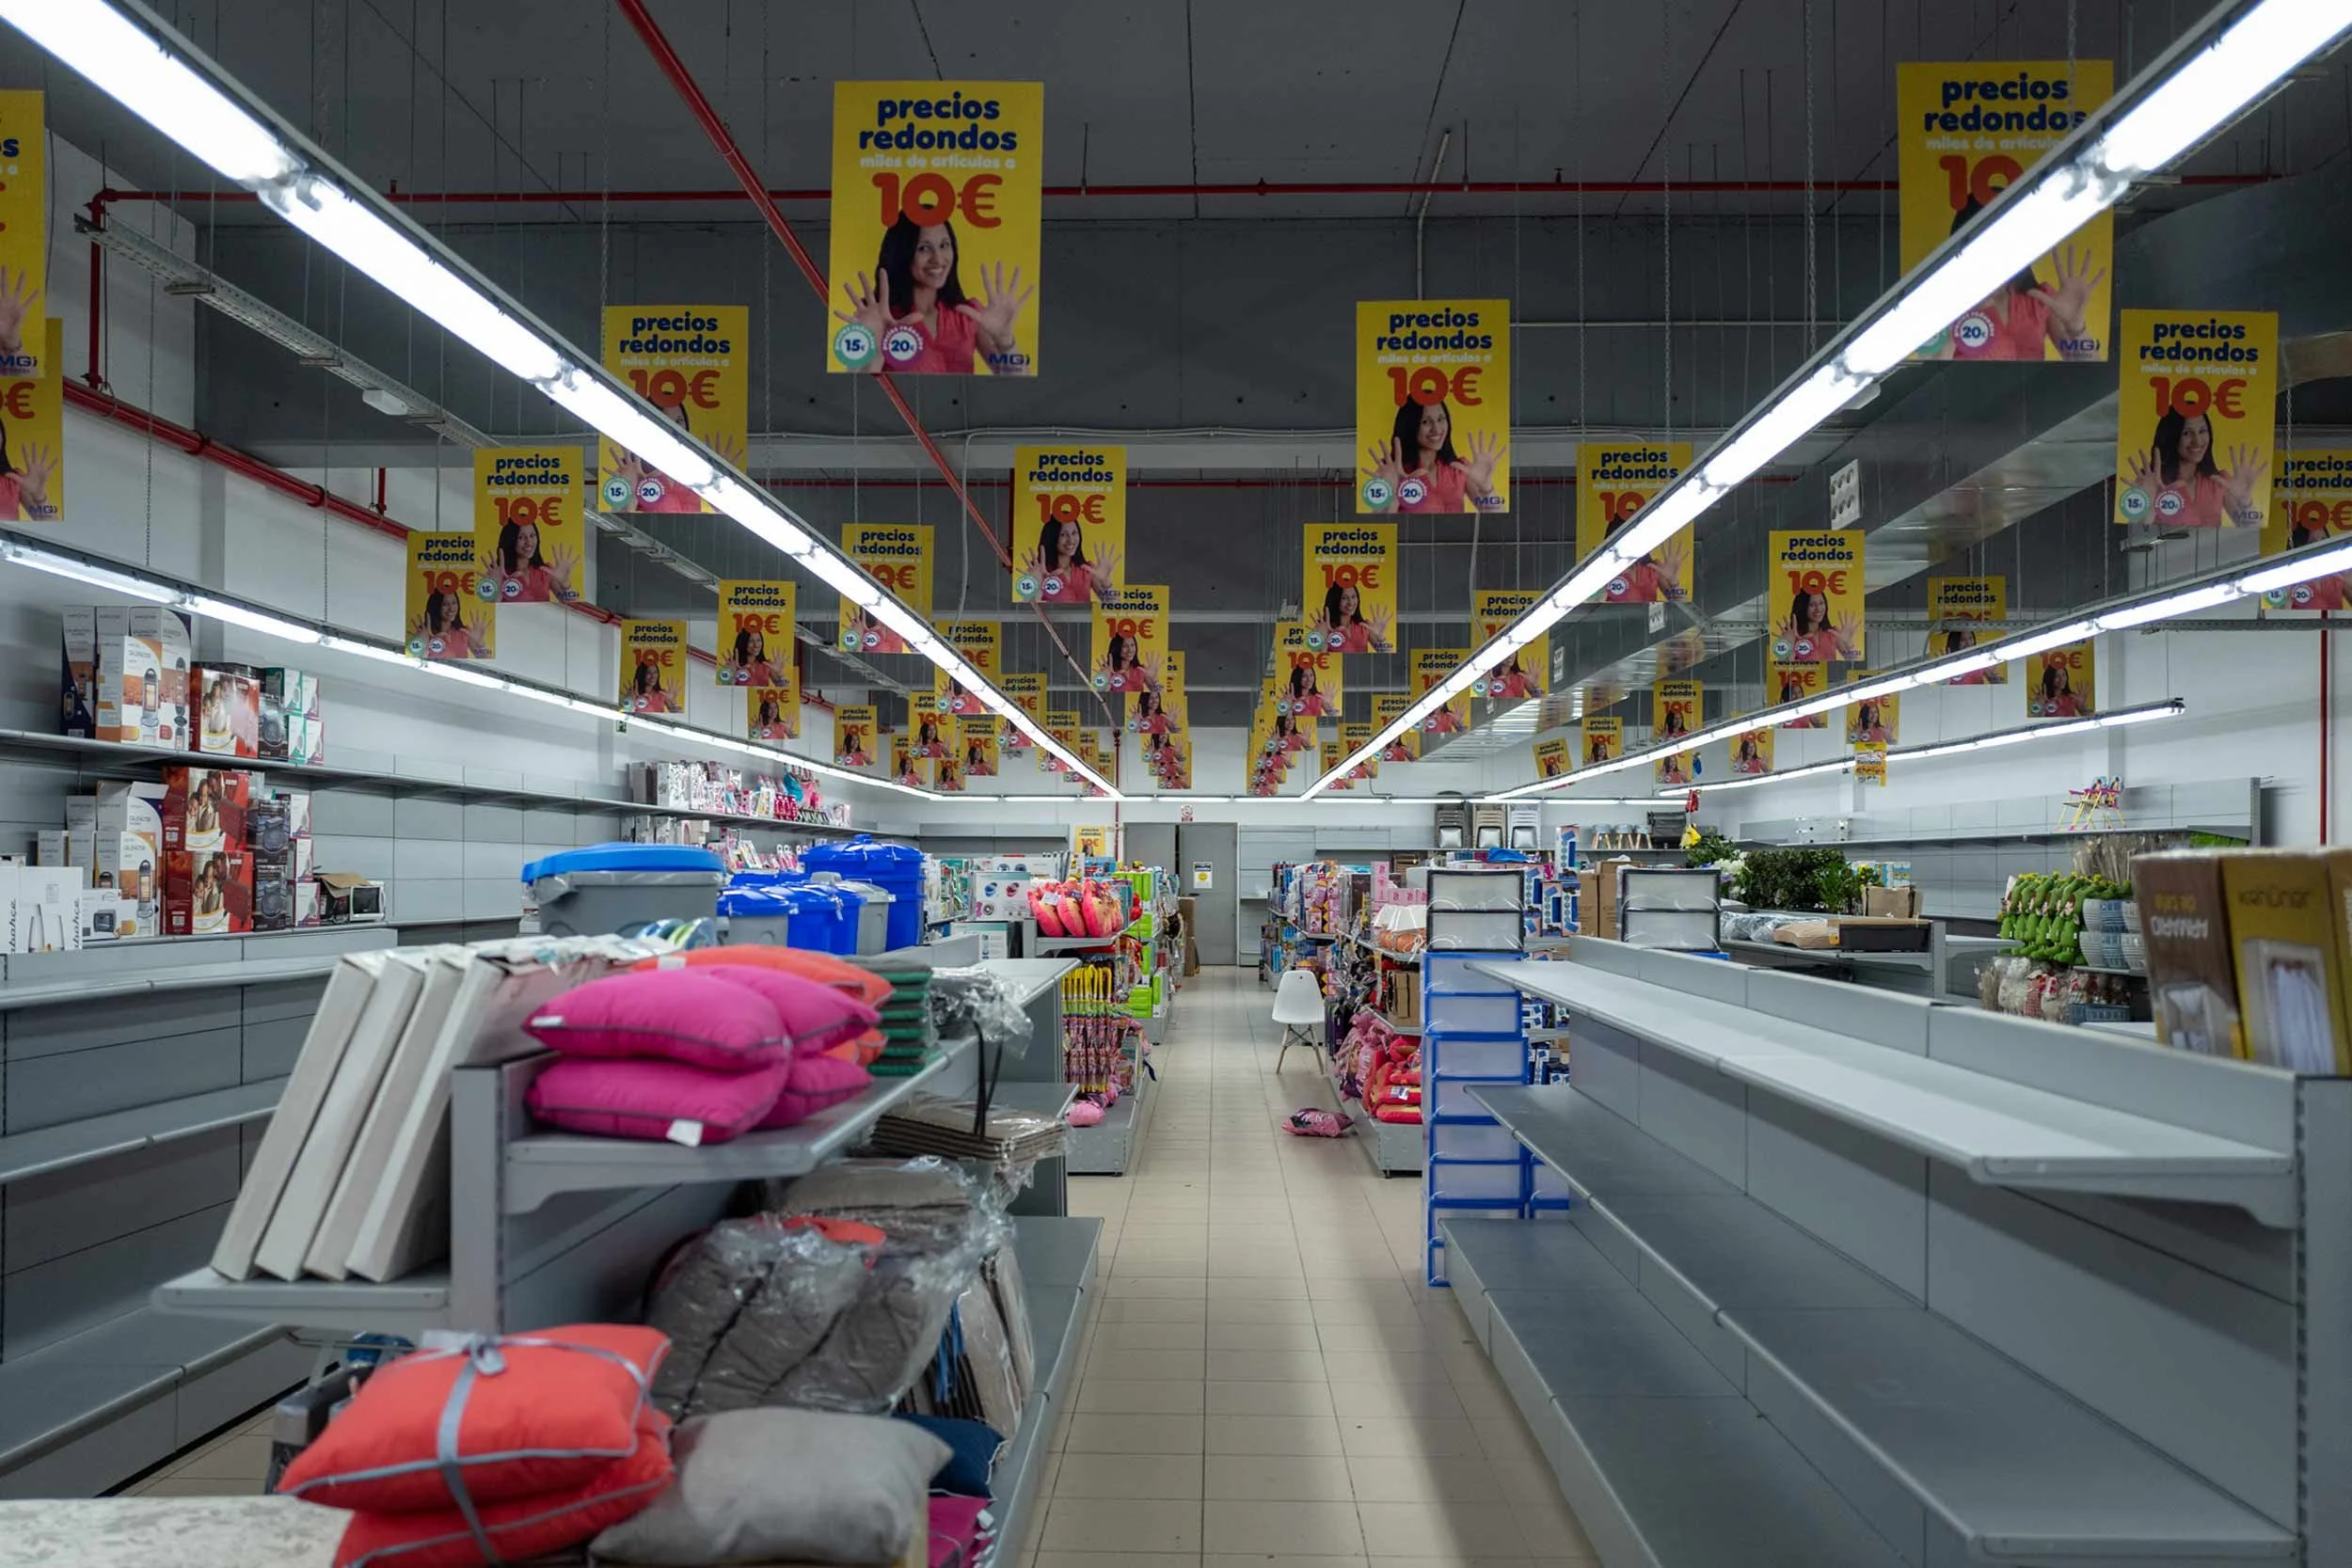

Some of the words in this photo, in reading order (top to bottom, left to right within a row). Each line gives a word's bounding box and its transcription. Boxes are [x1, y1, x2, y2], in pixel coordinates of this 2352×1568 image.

[1942, 72, 2069, 107] precios
[878, 91, 1000, 128] precios
[1923, 106, 2087, 132] redondos
[859, 125, 1017, 150] redondos
[1939, 155, 2023, 212] 10
[872, 172, 1003, 228] 10€
[632, 311, 718, 337] precios
[1391, 308, 1479, 332] precios
[2153, 319, 2245, 342] precios
[619, 335, 731, 354] redondos
[1376, 333, 1492, 350] redondos
[2140, 341, 2258, 361] redondos
[628, 370, 721, 408] 10€
[1387, 367, 1483, 406] 10€
[2150, 376, 2247, 418] 10€
[496, 454, 560, 472] precios
[1039, 451, 1104, 468] precios
[1601, 448, 1667, 466] precios
[486, 472, 569, 485] redondos
[1028, 467, 1113, 482] redondos
[1592, 465, 1678, 479] redondos
[2274, 475, 2352, 488] redondo
[494, 497, 563, 526] 10€
[1037, 494, 1105, 524] 10€
[1600, 491, 1646, 522] 10
[2281, 500, 2352, 531] 10€
[861, 529, 914, 543] precios
[1324, 529, 1377, 543] precios
[1789, 534, 1845, 549] precios
[418, 550, 473, 562] redondo
[1315, 543, 1385, 554] redondos
[1781, 549, 1853, 561] redondos
[1321, 564, 1379, 589] 10€
[1788, 570, 1847, 595] 10€
[735, 584, 779, 595] precios
[1944, 581, 1989, 594] precios
[728, 595, 786, 607] redondos
[1487, 594, 1534, 606] precios
[1937, 594, 1996, 604] redondos
[635, 624, 673, 633] precios
[733, 613, 780, 634] 10€
[633, 649, 674, 667] 10€
[1288, 652, 1329, 670] 10€
[1419, 660, 1457, 669] redondo
[1423, 652, 1458, 660] precios
[2040, 651, 2082, 670] 10€
[1779, 672, 1816, 687] 10€
[757, 689, 790, 704] 10€
